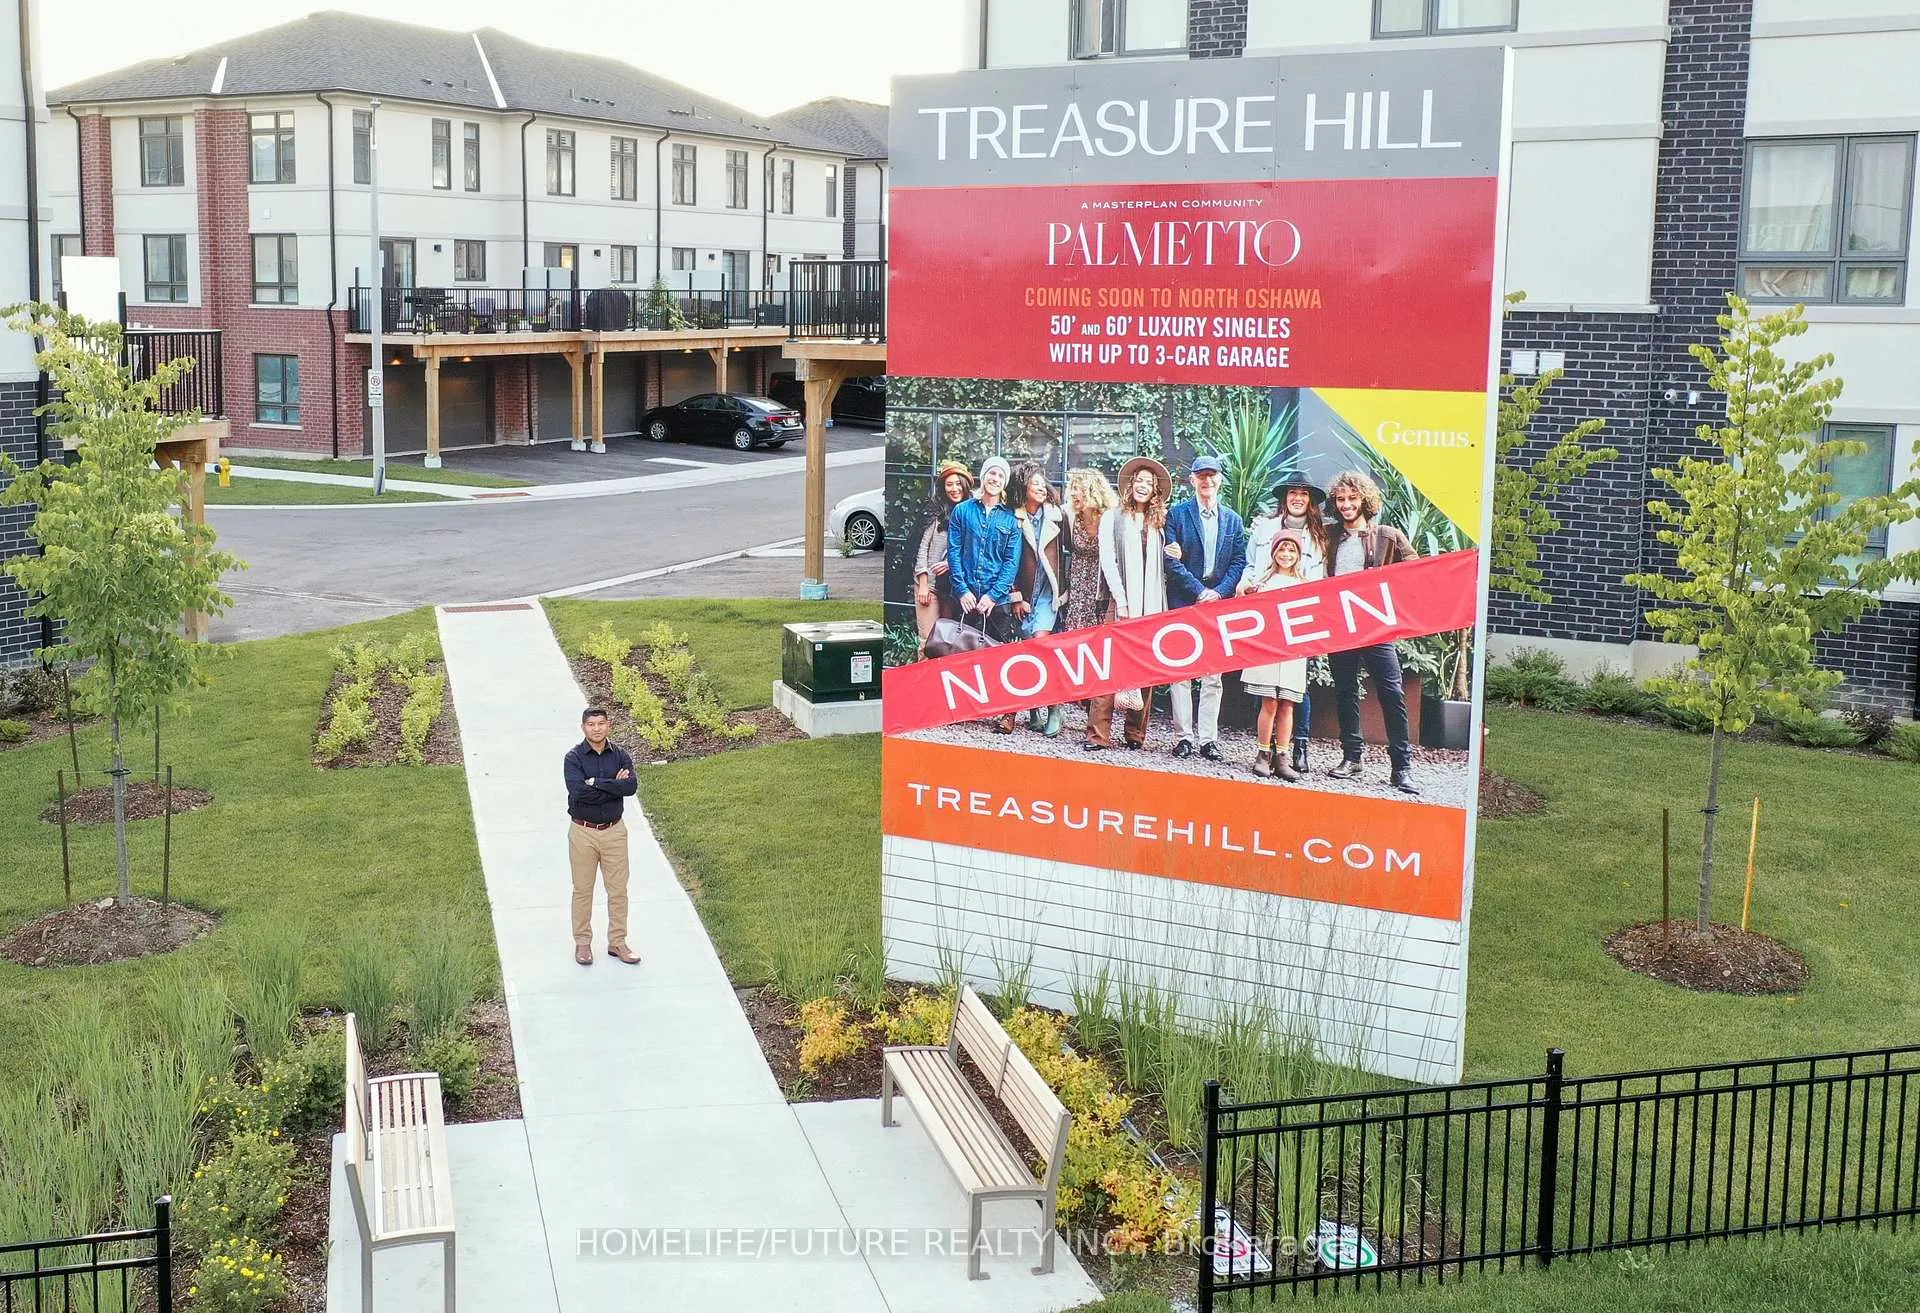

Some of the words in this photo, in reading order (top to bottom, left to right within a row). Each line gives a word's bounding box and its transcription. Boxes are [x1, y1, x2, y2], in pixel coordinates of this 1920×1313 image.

[918, 96, 1276, 161] TREASURE
[1304, 89, 1462, 151] HILL
[1092, 200, 1177, 209] MASTERPLAN
[1182, 199, 1264, 208] COMMUNITY
[1045, 219, 1301, 267] PALMETTO
[1025, 287, 1091, 308] COMING
[1100, 287, 1142, 308] SOON
[1151, 288, 1172, 309] TO
[1179, 288, 1238, 309] NORTH
[1245, 288, 1322, 309] OSHAWA
[1081, 323, 1100, 336] AND
[1138, 316, 1208, 338] LUXURY
[1212, 317, 1291, 339] SINGLES
[1049, 343, 1092, 364] WITH
[1099, 344, 1123, 365] UP
[1128, 344, 1149, 365] TO
[1155, 345, 1210, 367] 3-CAR
[1216, 346, 1290, 369] GARAGE
[940, 636, 1113, 711] NOW
[1151, 581, 1399, 668] OPEN
[907, 782, 1421, 877] TREASUREHILL.COM
